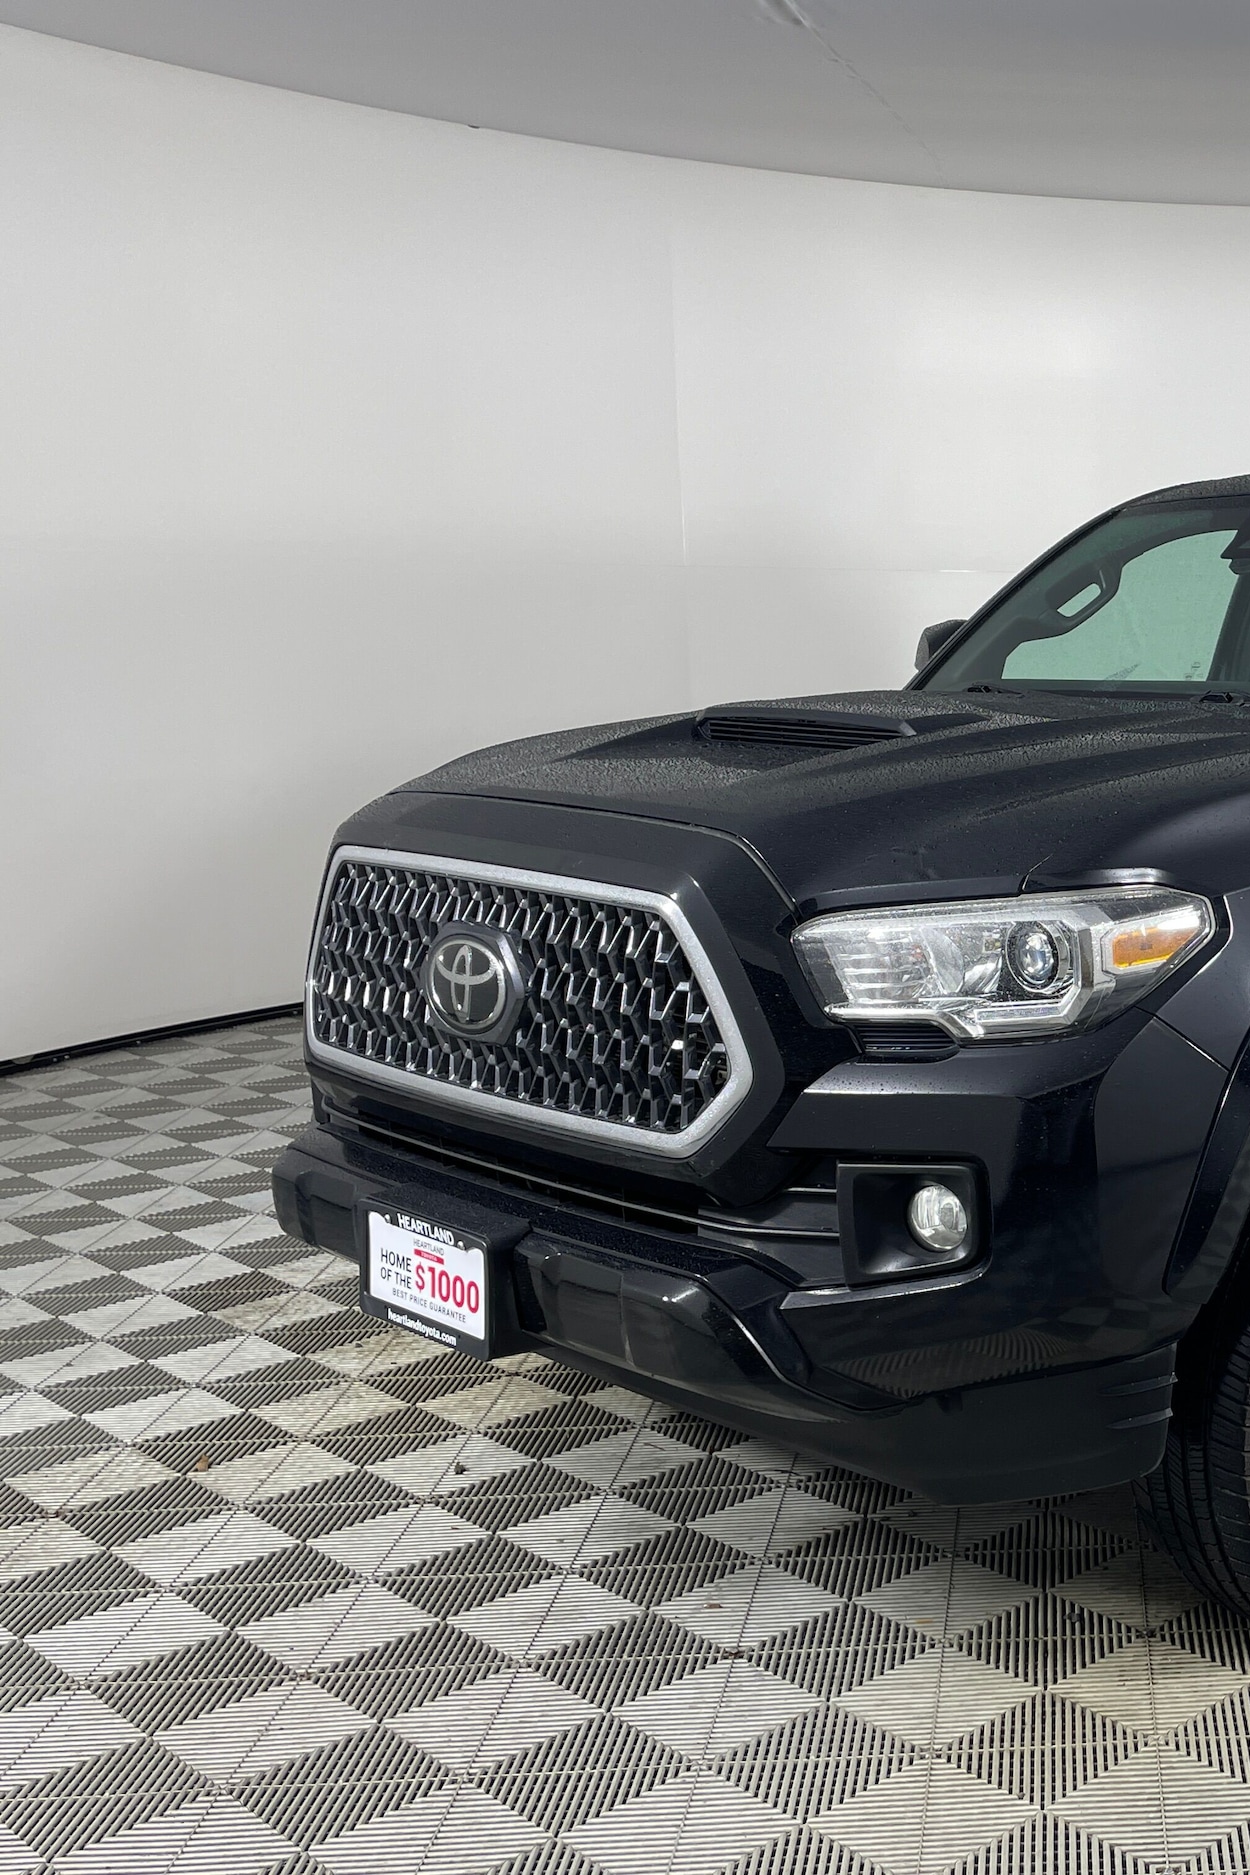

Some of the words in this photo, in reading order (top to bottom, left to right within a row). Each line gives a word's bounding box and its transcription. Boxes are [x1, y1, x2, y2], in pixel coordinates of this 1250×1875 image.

[397, 1213, 455, 1245] HEARTLAND
[380, 1247, 412, 1273] HOME
[413, 1238, 445, 1256] HEARTLAND
[380, 1266, 393, 1282] OF
[394, 1271, 412, 1290] THE
[415, 1262, 479, 1314] $1000
[392, 1287, 408, 1301] BEST
[409, 1294, 428, 1309] PRICE
[429, 1301, 467, 1323] GUARANTEE
[387, 1307, 457, 1346] heartlandtoyota.com
